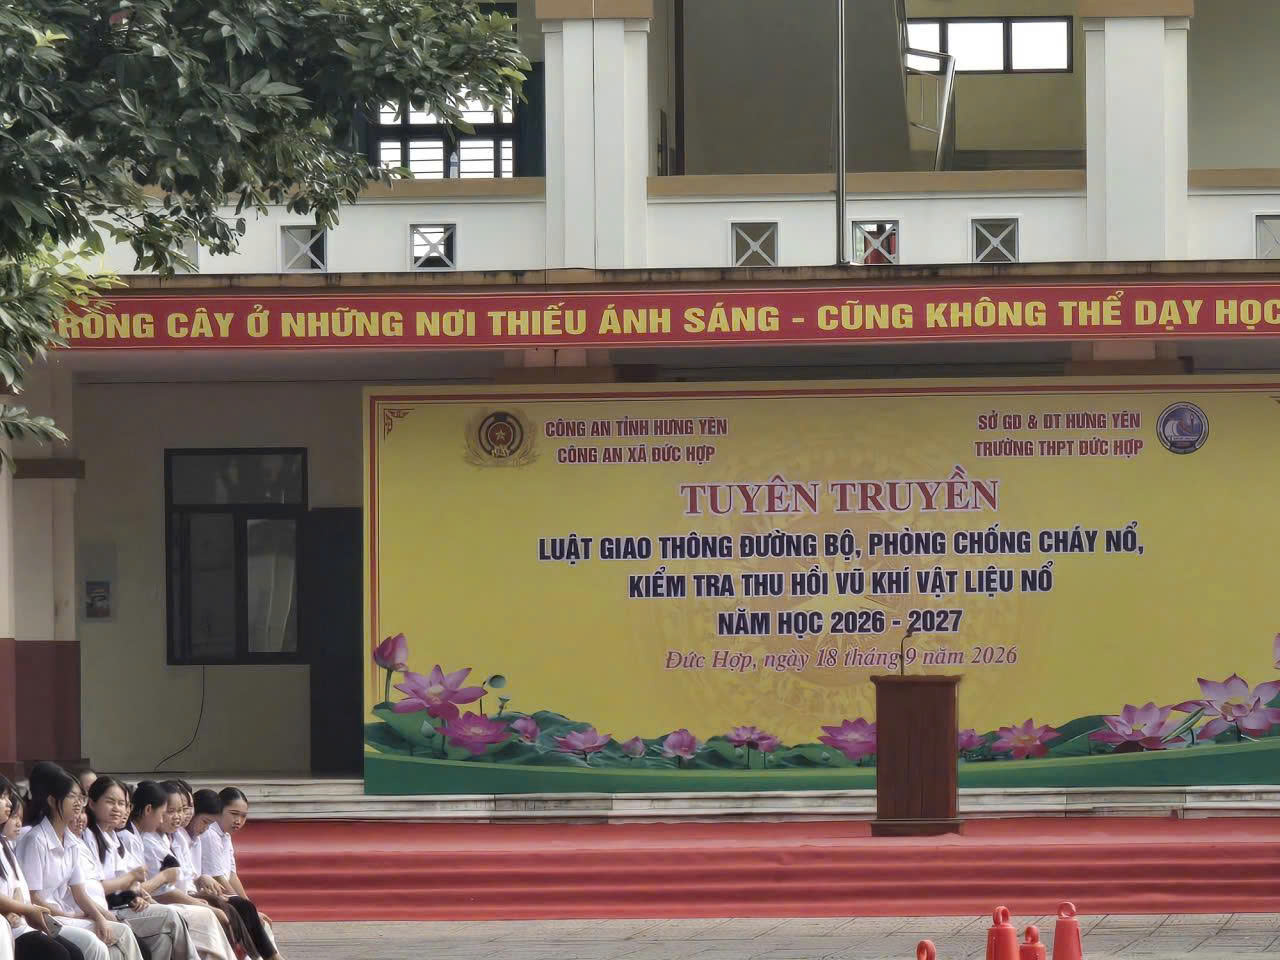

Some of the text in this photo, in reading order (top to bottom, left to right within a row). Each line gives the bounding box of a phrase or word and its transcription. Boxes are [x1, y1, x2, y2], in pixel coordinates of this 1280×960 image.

[167, 307, 235, 339] CÂY
[247, 304, 270, 338] Ở
[281, 306, 404, 338] NHỮNG
[416, 308, 477, 337] NƠI
[488, 302, 587, 337] THIẾU
[599, 303, 671, 335] ÁNH
[683, 302, 780, 333] SÁNG
[817, 300, 914, 331] CŨNG
[926, 296, 1047, 329] KHÔNG
[1058, 290, 1124, 327] THỂ
[1135, 299, 1204, 331] DẠY
[545, 416, 727, 437] CÔNG AN TỈNH HƯNG YÊN
[978, 410, 998, 430] SỞ
[1027, 415, 1038, 430] &
[1065, 412, 1107, 429] HƯNG
[1112, 410, 1141, 429] YÊN
[557, 445, 598, 463] CÔNG
[602, 447, 623, 463] AN
[627, 444, 647, 462] XÃ
[685, 444, 716, 465] HỢP
[975, 437, 1034, 457] TRƯỜNG
[1039, 440, 1075, 456] THPT
[1114, 438, 1143, 459] HỢP
[680, 464, 999, 515] TUYÊN TRUYỀN
[539, 521, 1144, 565] LUẬT GIAO THÔNG ĐƯỜNG BỘ, PHÒNG CHỐNG CHÁY NỔ,
[629, 560, 1054, 599] KIỂM TRA THU HỒI VŨ KHÍ VẬT LIỆU NỔ
[718, 608, 964, 640] NĂM HỌC 2026 - 2027
[665, 646, 1018, 674] Đức Hợp, ngày 18 tháng 9 năm 2026
